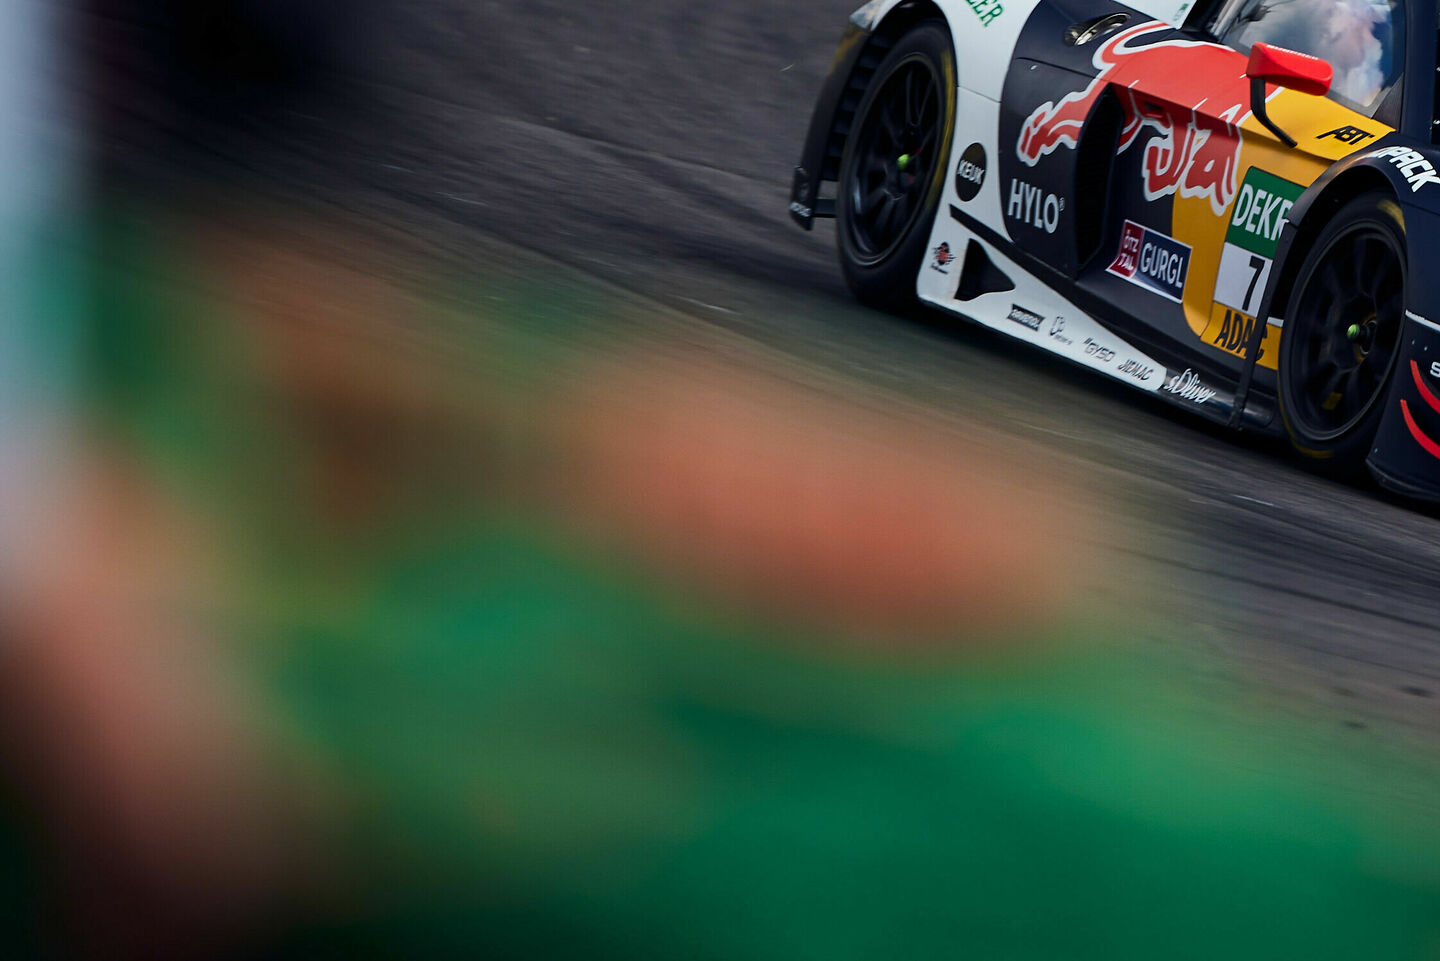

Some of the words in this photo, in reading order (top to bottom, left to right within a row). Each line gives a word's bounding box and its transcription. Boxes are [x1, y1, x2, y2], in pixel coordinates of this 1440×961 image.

[1315, 125, 1374, 146] ABT
[1140, 242, 1184, 289] GURGL
[1242, 255, 1266, 312] 7
